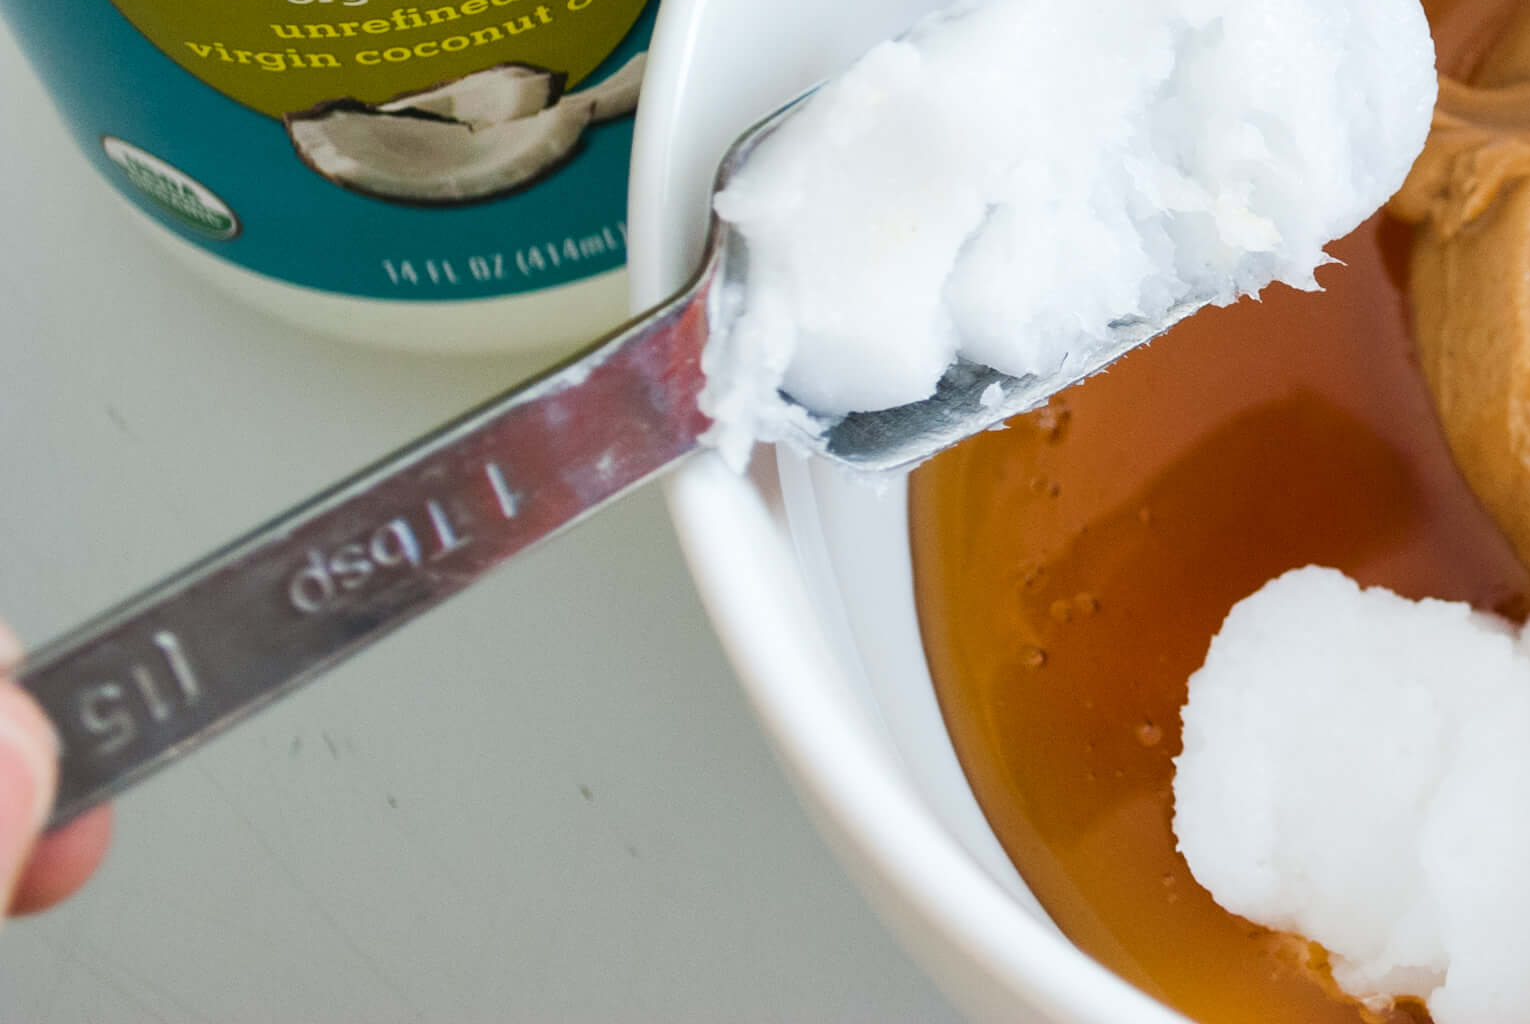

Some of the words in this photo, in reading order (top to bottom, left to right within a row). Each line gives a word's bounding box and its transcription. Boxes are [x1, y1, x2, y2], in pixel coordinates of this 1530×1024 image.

[185, 40, 342, 73] virgin
[355, 5, 555, 67] coconut
[486, 462, 529, 519] 1
[289, 499, 472, 612] Tbsp
